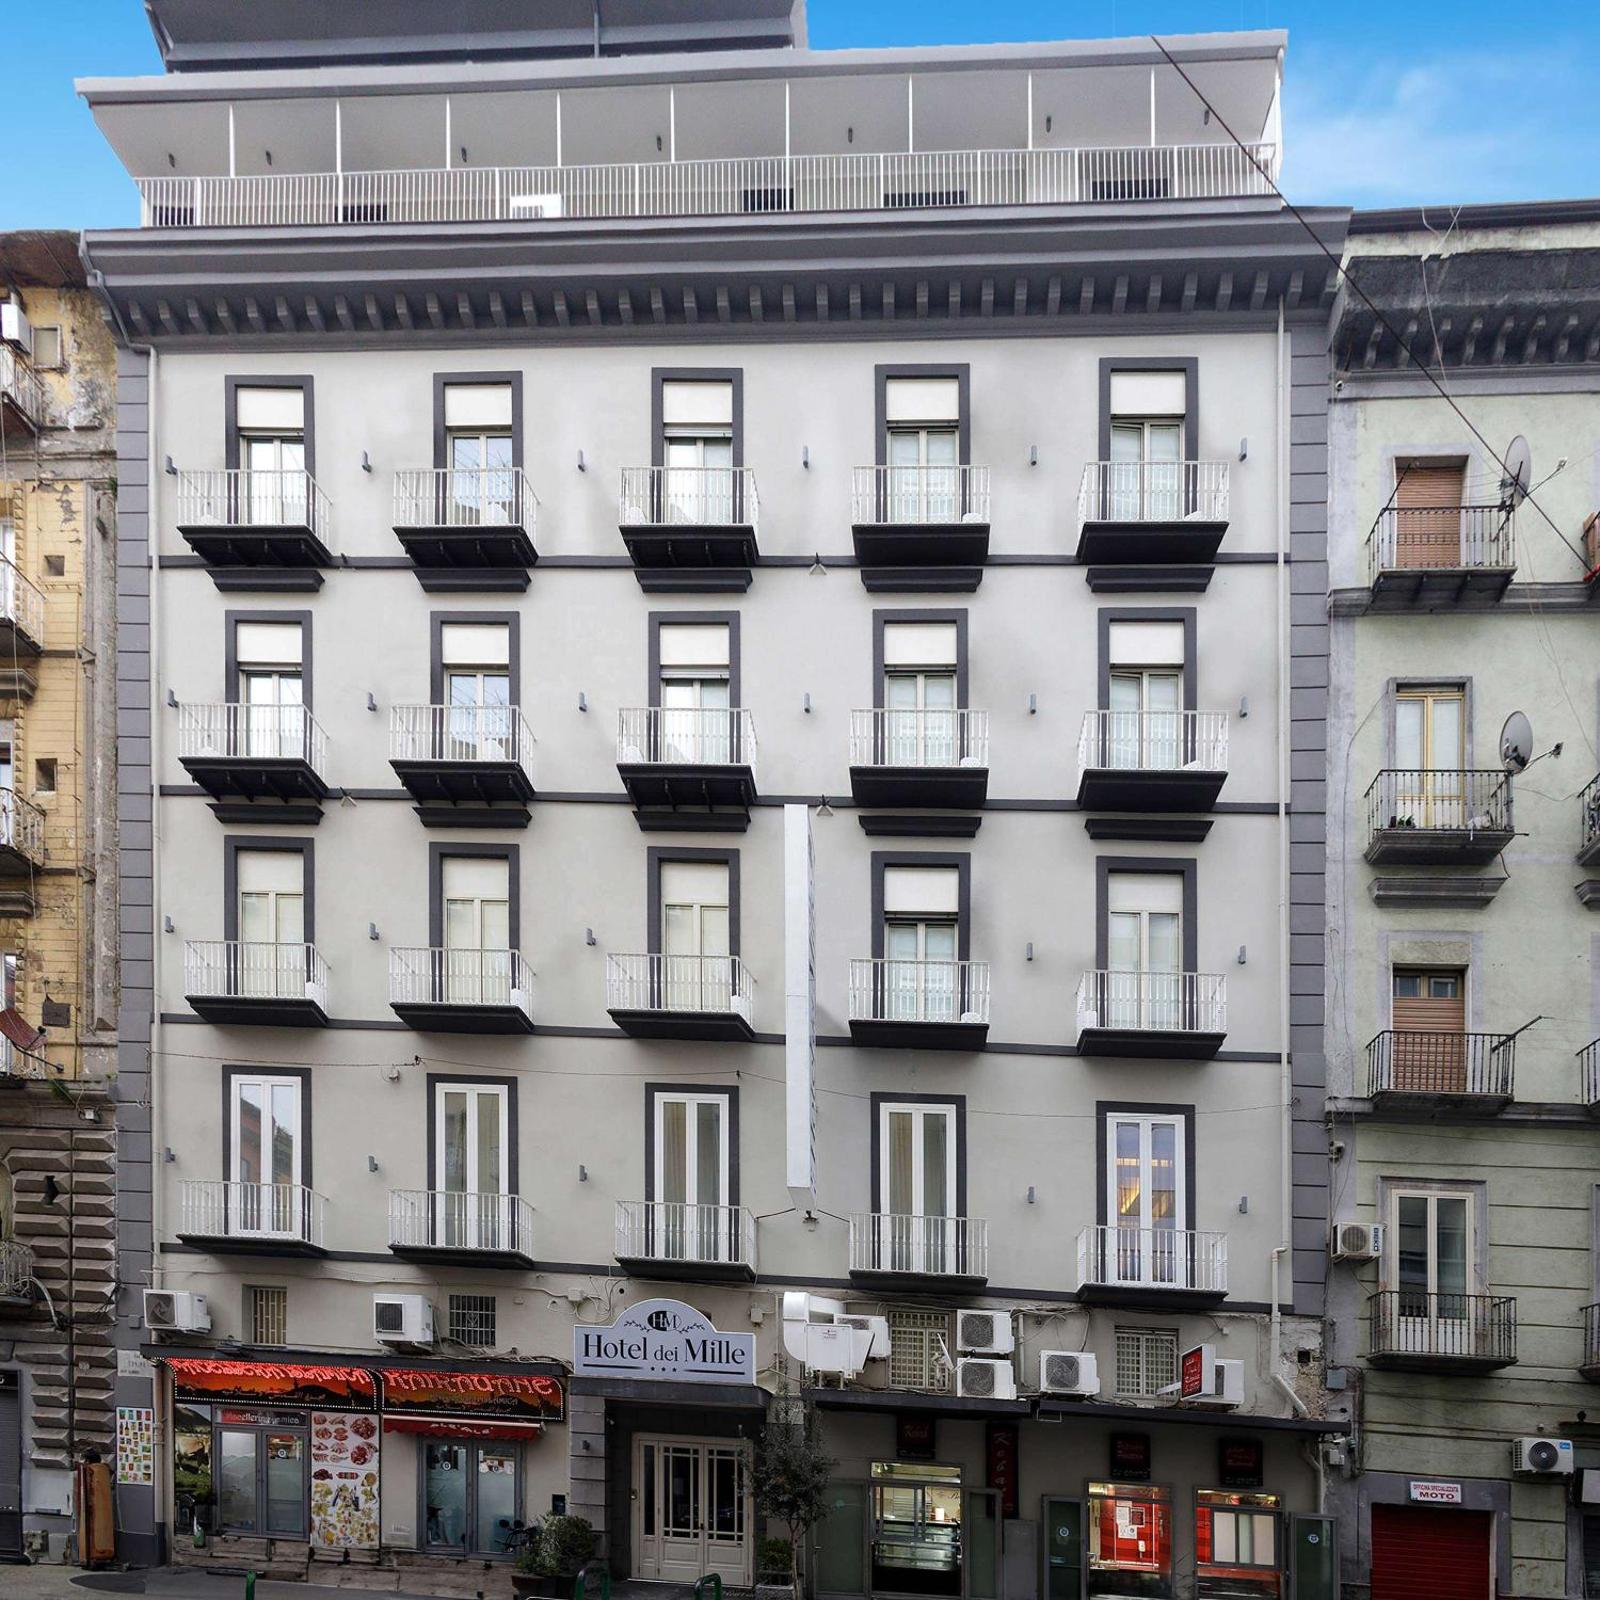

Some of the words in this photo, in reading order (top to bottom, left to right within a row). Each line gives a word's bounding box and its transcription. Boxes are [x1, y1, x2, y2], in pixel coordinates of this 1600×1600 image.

[584, 1333, 648, 1361] Hotel
[653, 1344, 679, 1361] dei
[684, 1338, 746, 1364] Mille
[1419, 1491, 1455, 1500] MOTO
